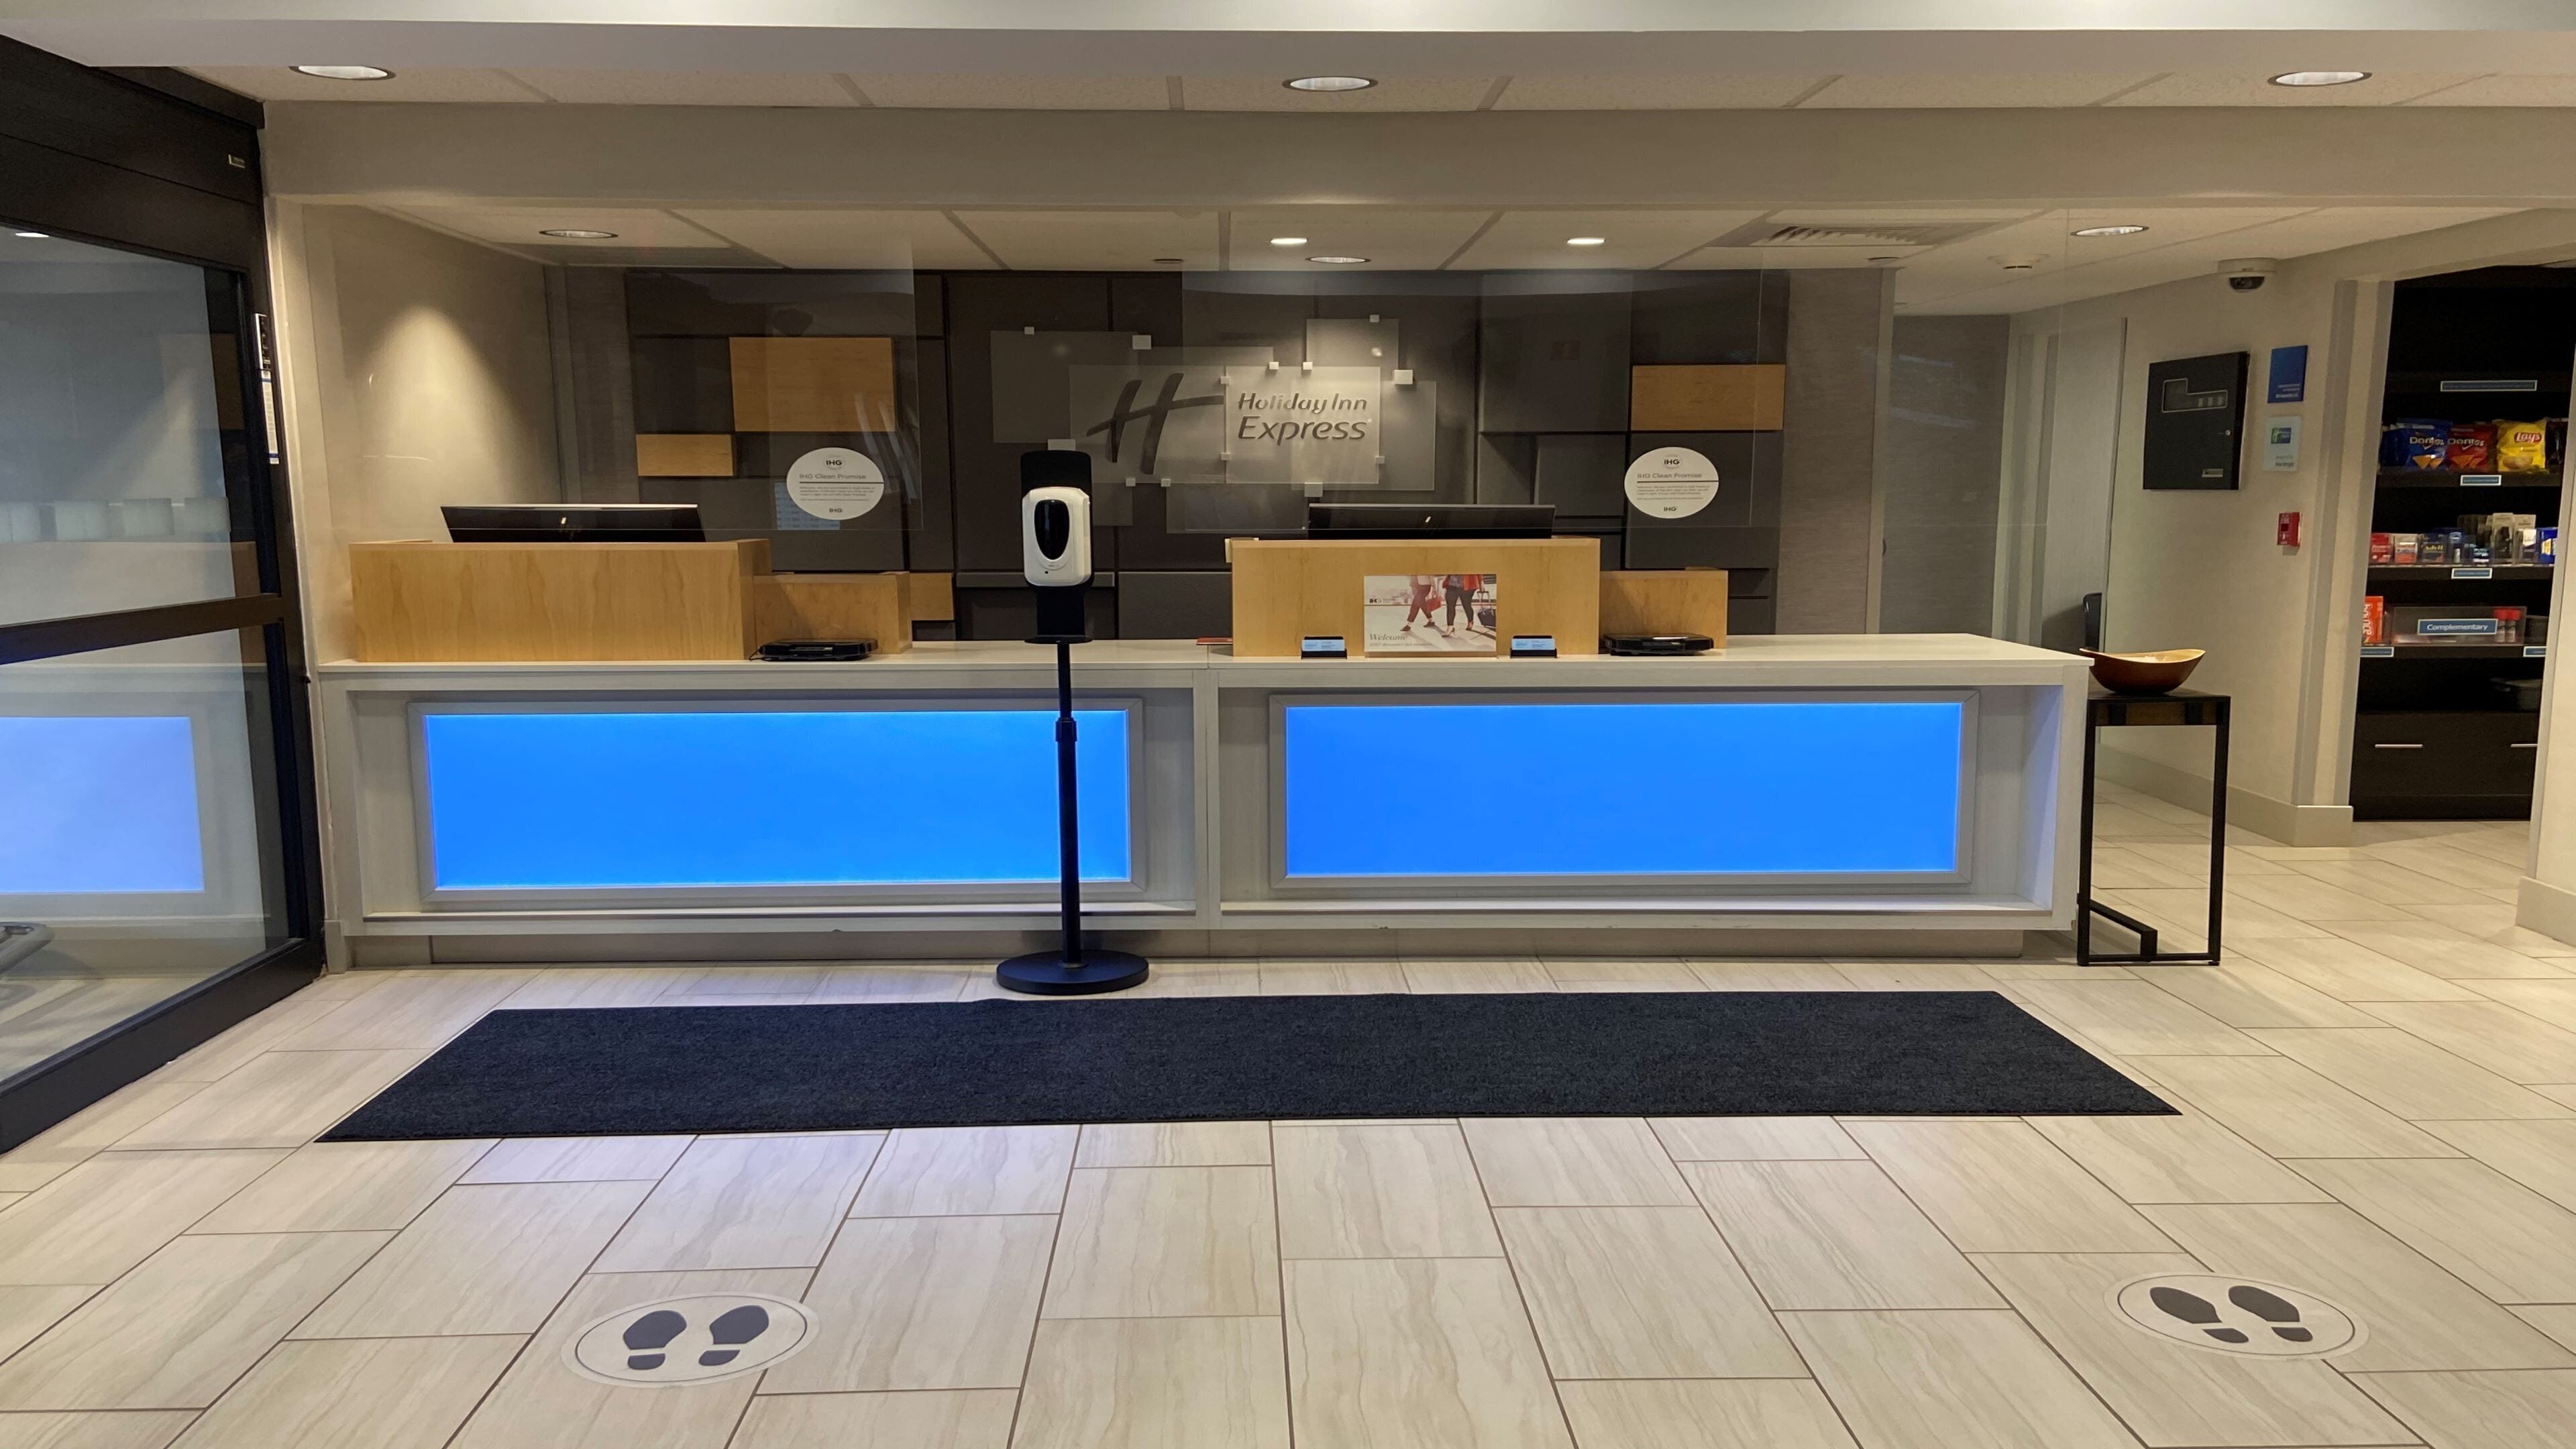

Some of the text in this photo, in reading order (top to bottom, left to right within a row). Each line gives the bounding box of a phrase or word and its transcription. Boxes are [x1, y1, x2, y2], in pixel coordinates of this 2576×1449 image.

[1238, 392, 1368, 415] Holiday Inn
[1238, 415, 1367, 446] Express
[2409, 436, 2445, 445] Doritos
[2448, 437, 2485, 446] Doritos
[2426, 623, 2488, 631] Complementary
